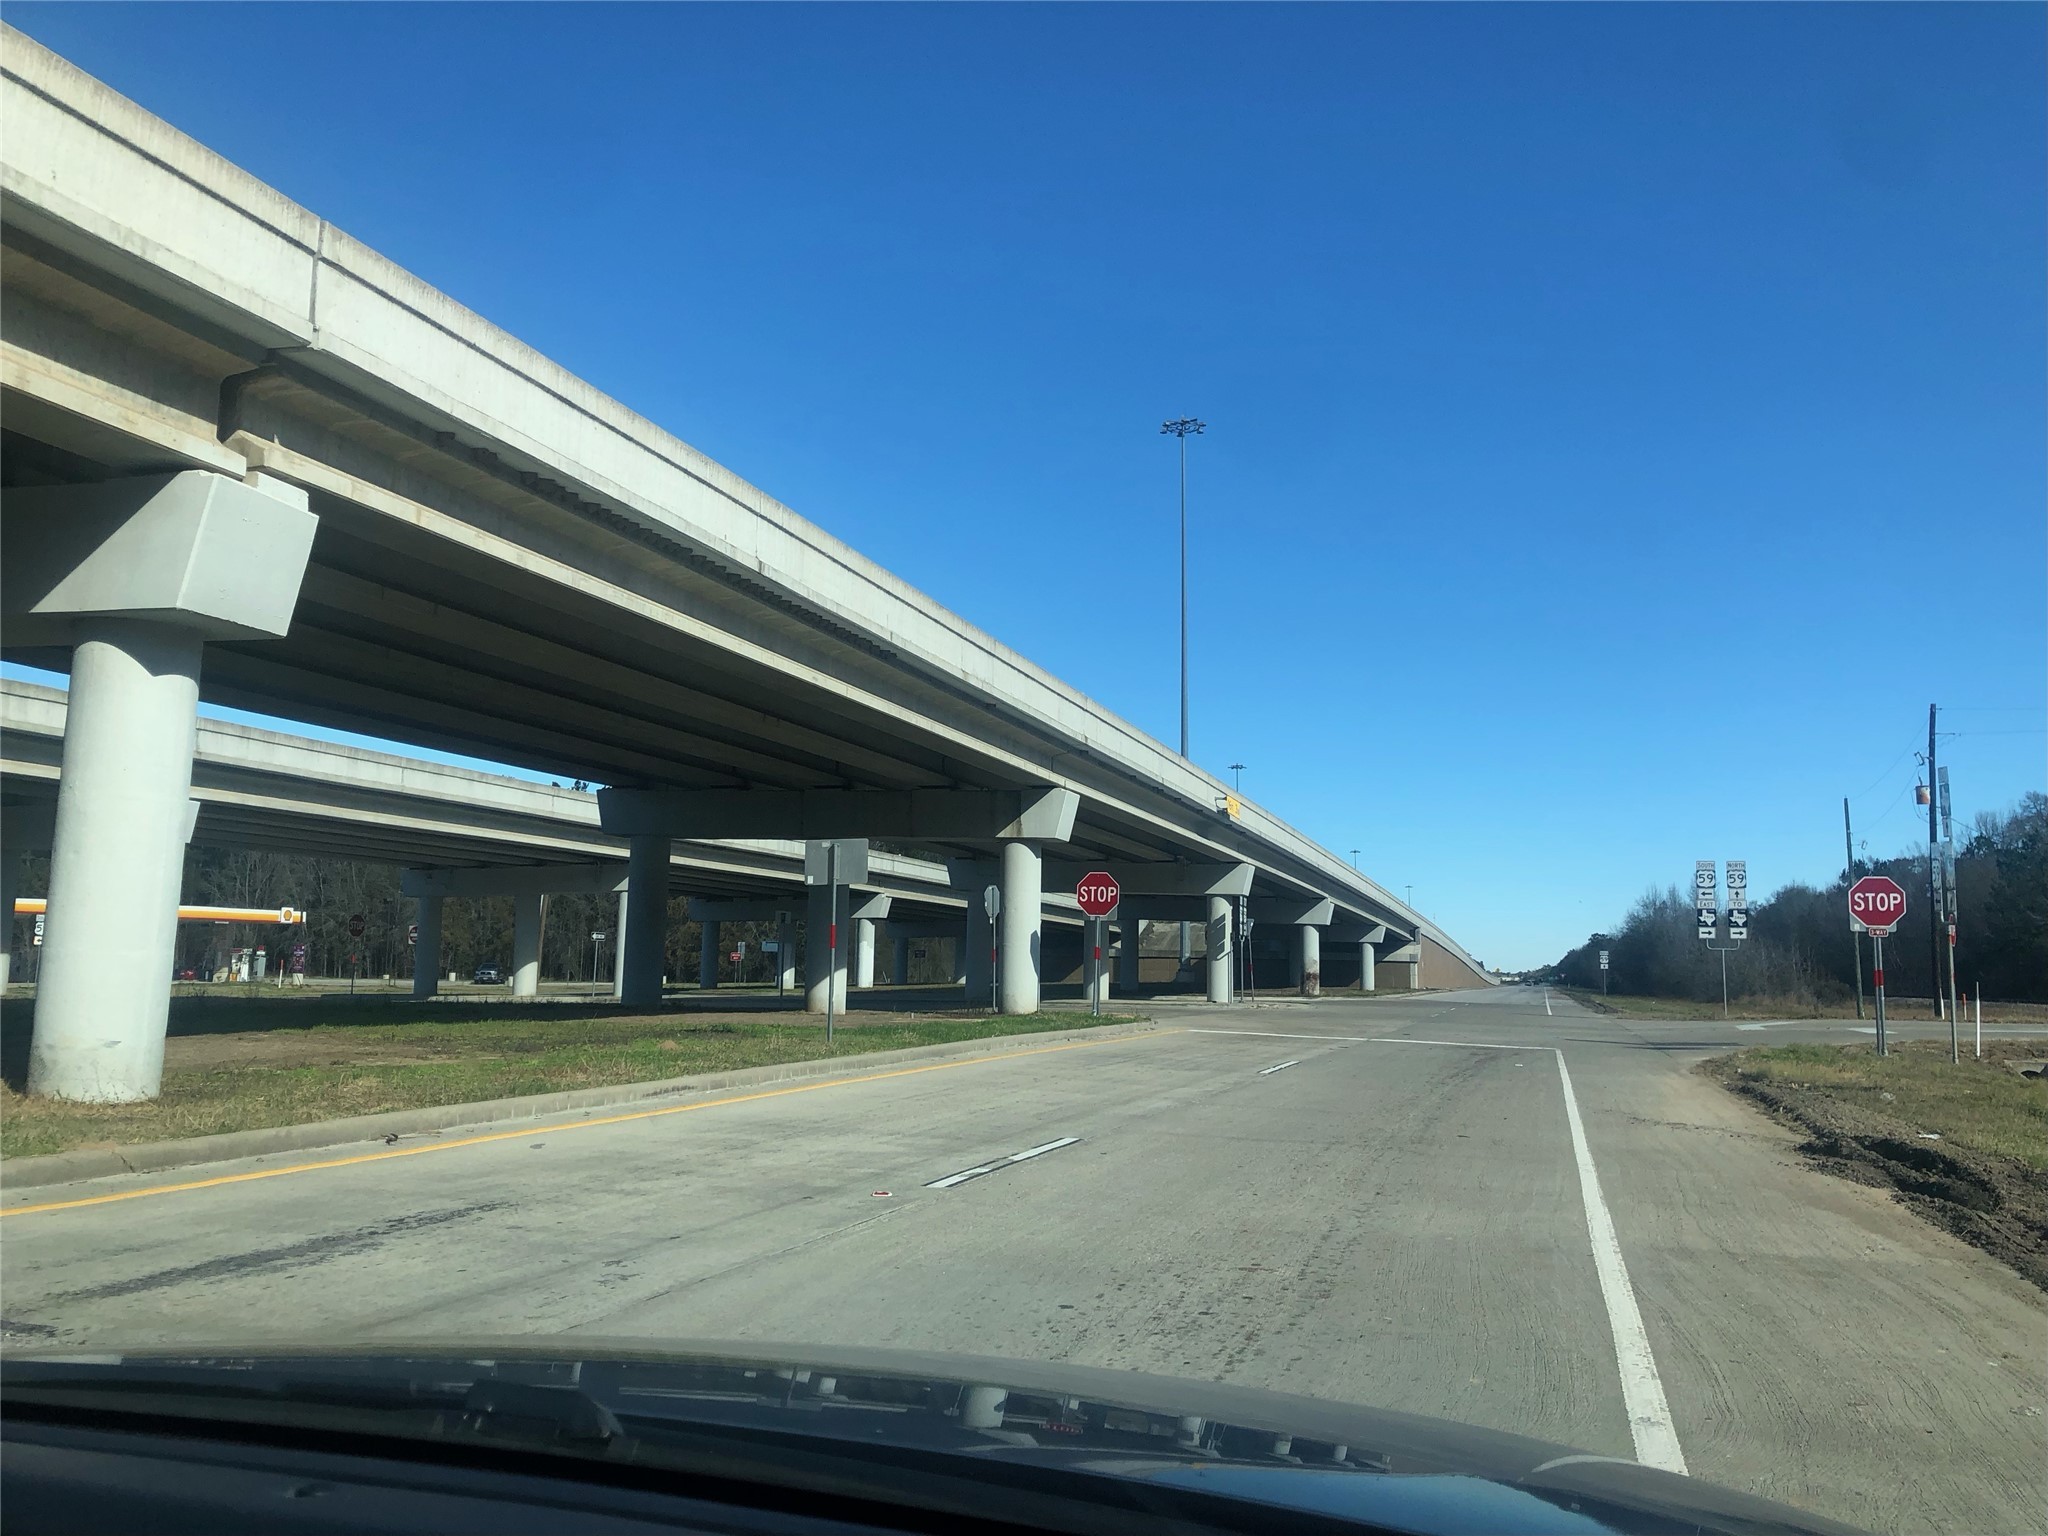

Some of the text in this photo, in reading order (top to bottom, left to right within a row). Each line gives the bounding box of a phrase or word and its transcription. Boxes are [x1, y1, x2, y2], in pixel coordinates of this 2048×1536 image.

[1698, 873, 1714, 884] 59
[1729, 873, 1745, 884] 59
[1079, 886, 1117, 902] STOP
[1853, 892, 1901, 911] STOP
[350, 921, 365, 930] STOP
